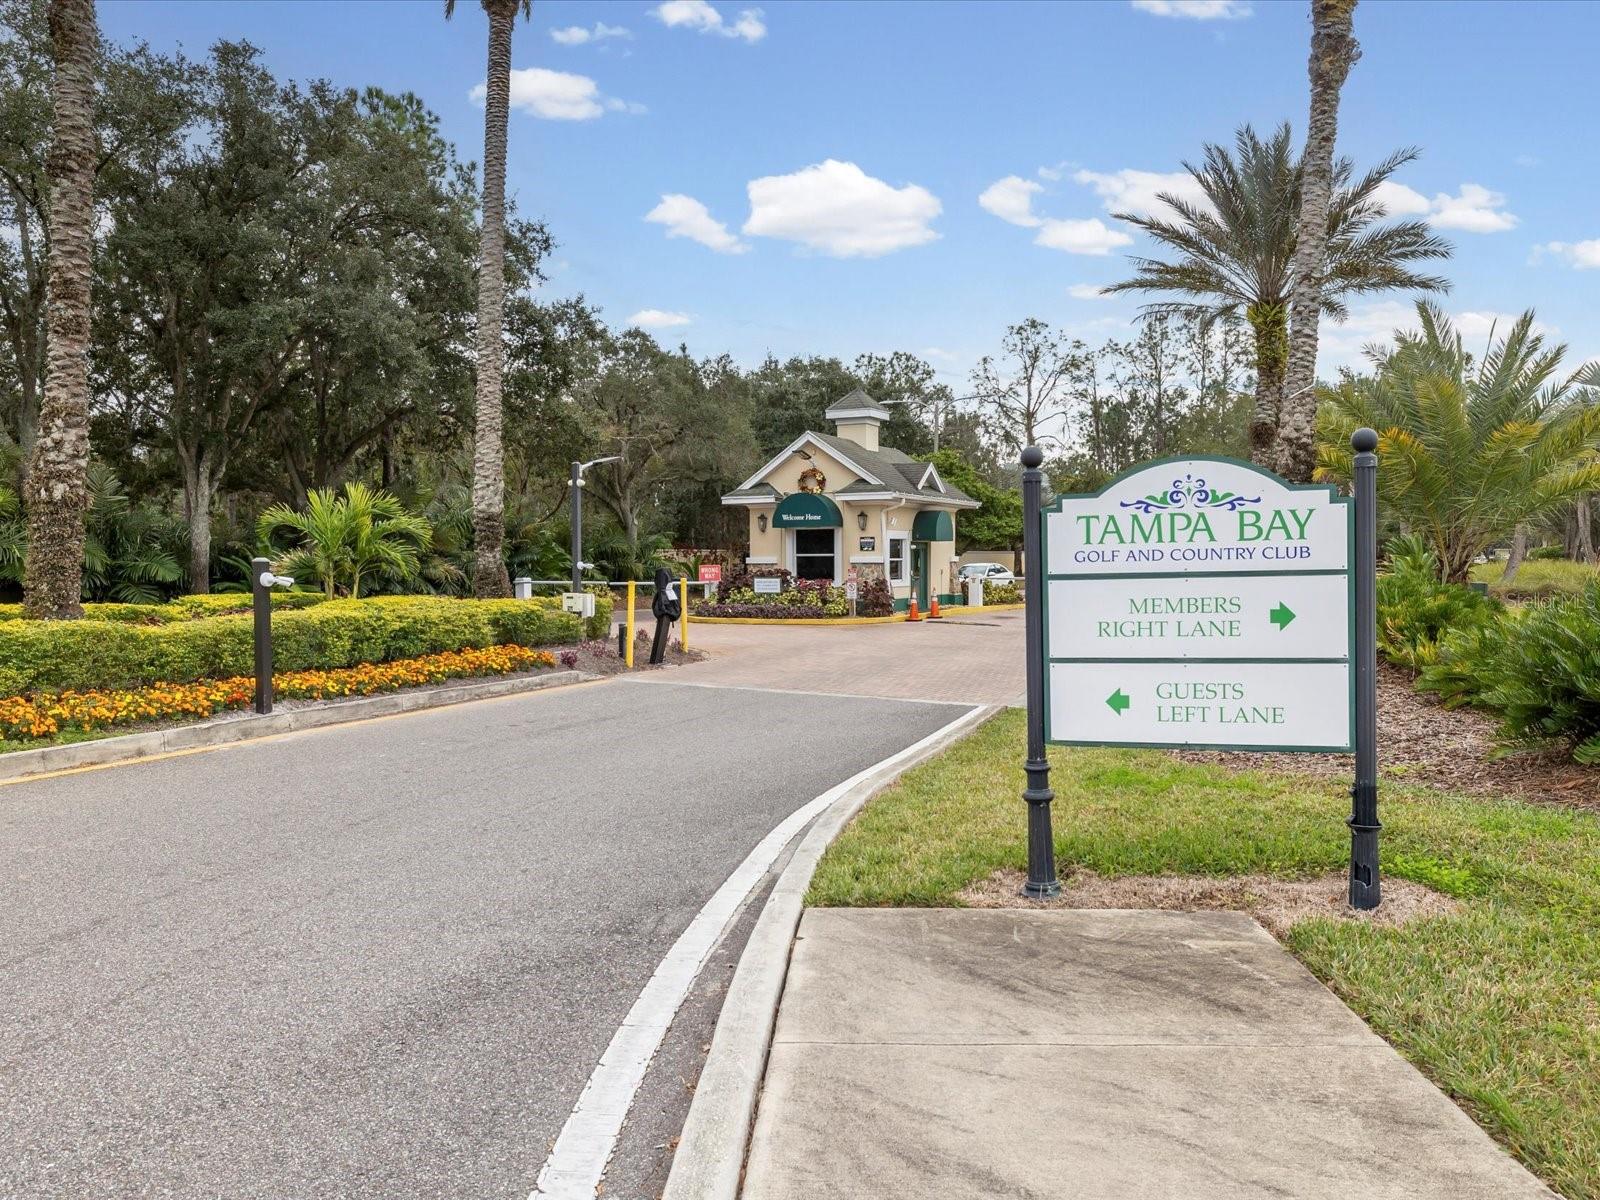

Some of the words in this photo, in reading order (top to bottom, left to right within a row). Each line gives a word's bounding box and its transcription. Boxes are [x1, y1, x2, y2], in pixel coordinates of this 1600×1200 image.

[781, 513, 804, 521] Welcome
[805, 513, 822, 521] Home
[1076, 512, 1217, 545] TAMPA
[1237, 509, 1317, 542] BAY
[1074, 549, 1120, 563] GOLF
[1125, 549, 1165, 562] AND
[1170, 547, 1256, 561] COUNTRY
[1262, 545, 1311, 560] CLUB
[1129, 596, 1242, 614] MEMBERS
[1098, 620, 1169, 638] RIGHT
[1176, 620, 1242, 637] LANE
[1156, 683, 1244, 700] GUESTS
[1157, 705, 1211, 723] LEFT
[1219, 706, 1285, 724] LANE
